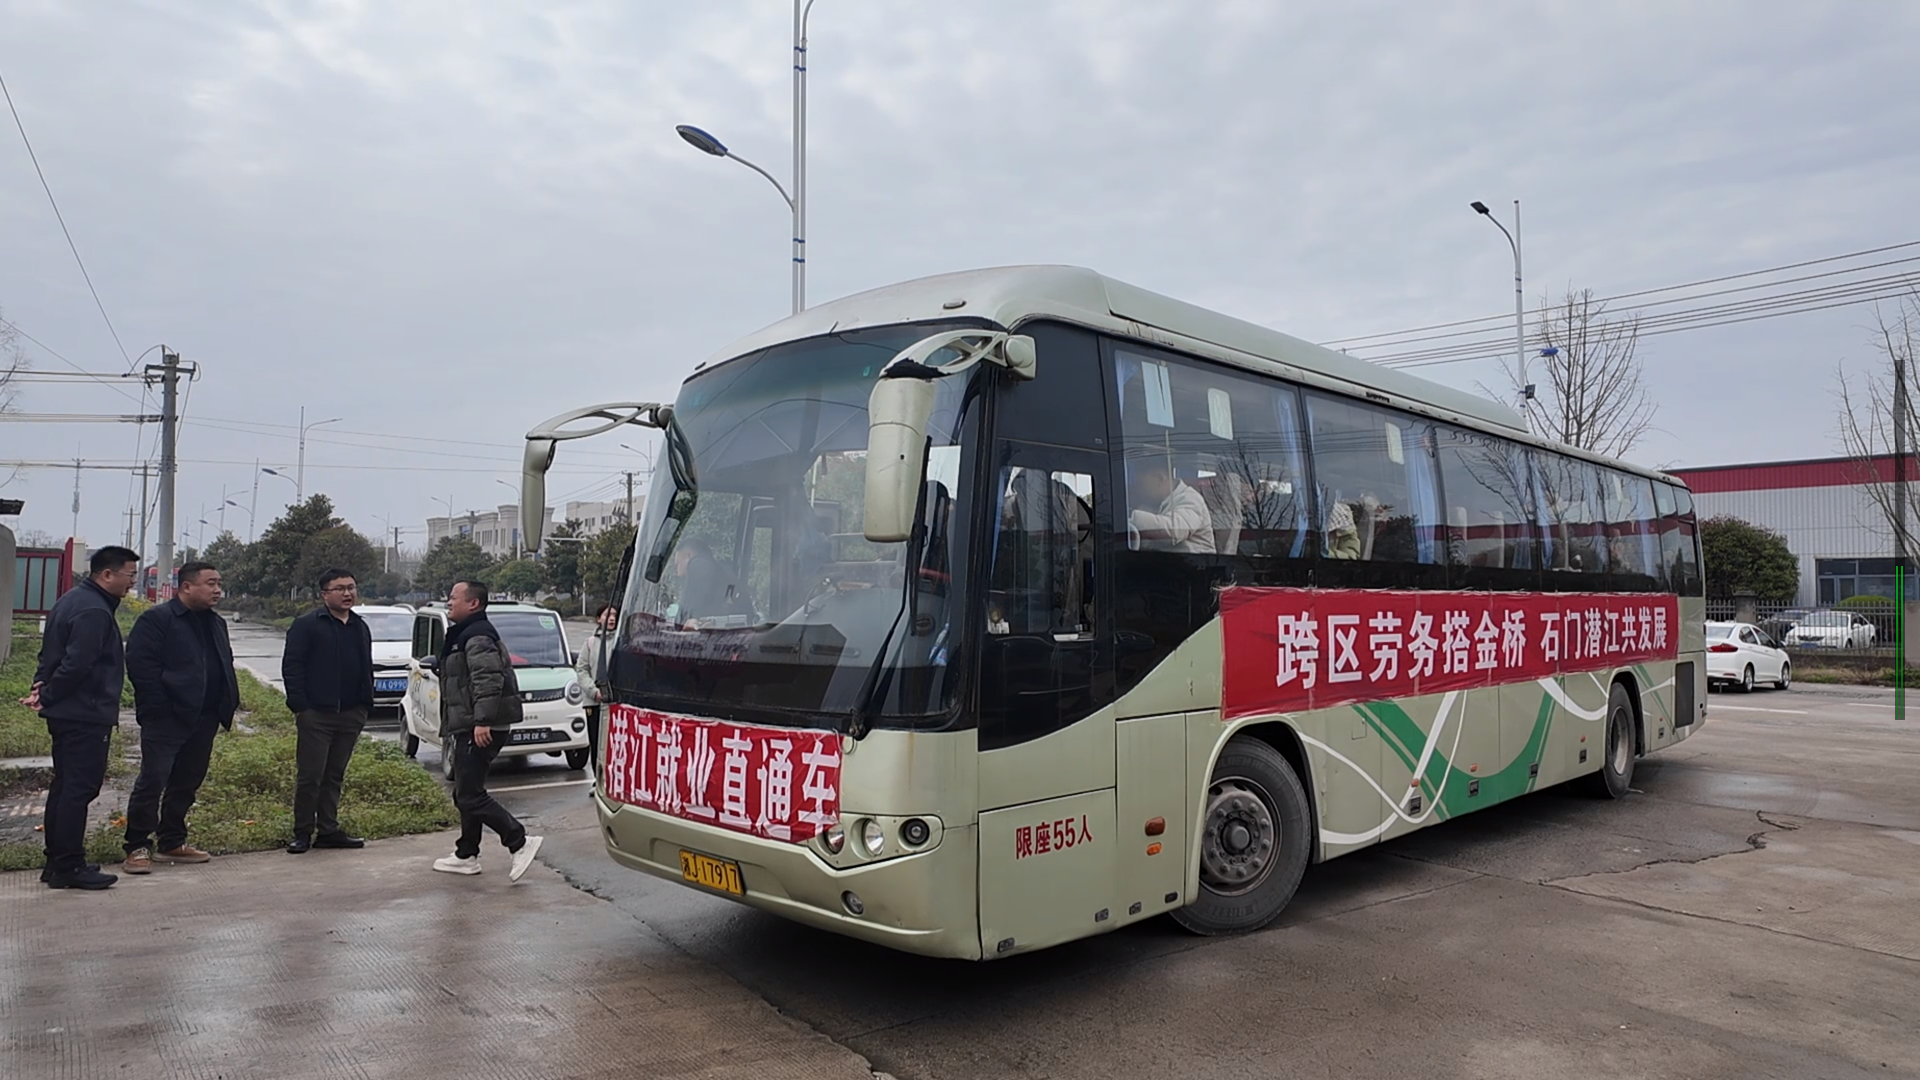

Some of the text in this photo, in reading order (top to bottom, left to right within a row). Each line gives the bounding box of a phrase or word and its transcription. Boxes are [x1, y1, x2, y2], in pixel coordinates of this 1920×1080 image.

[1276, 605, 1668, 690] 跨区劳务搭金桥 石门潜江共发展
[606, 709, 841, 841] 潜江就业直通车
[1015, 814, 1093, 860] 限座55人
